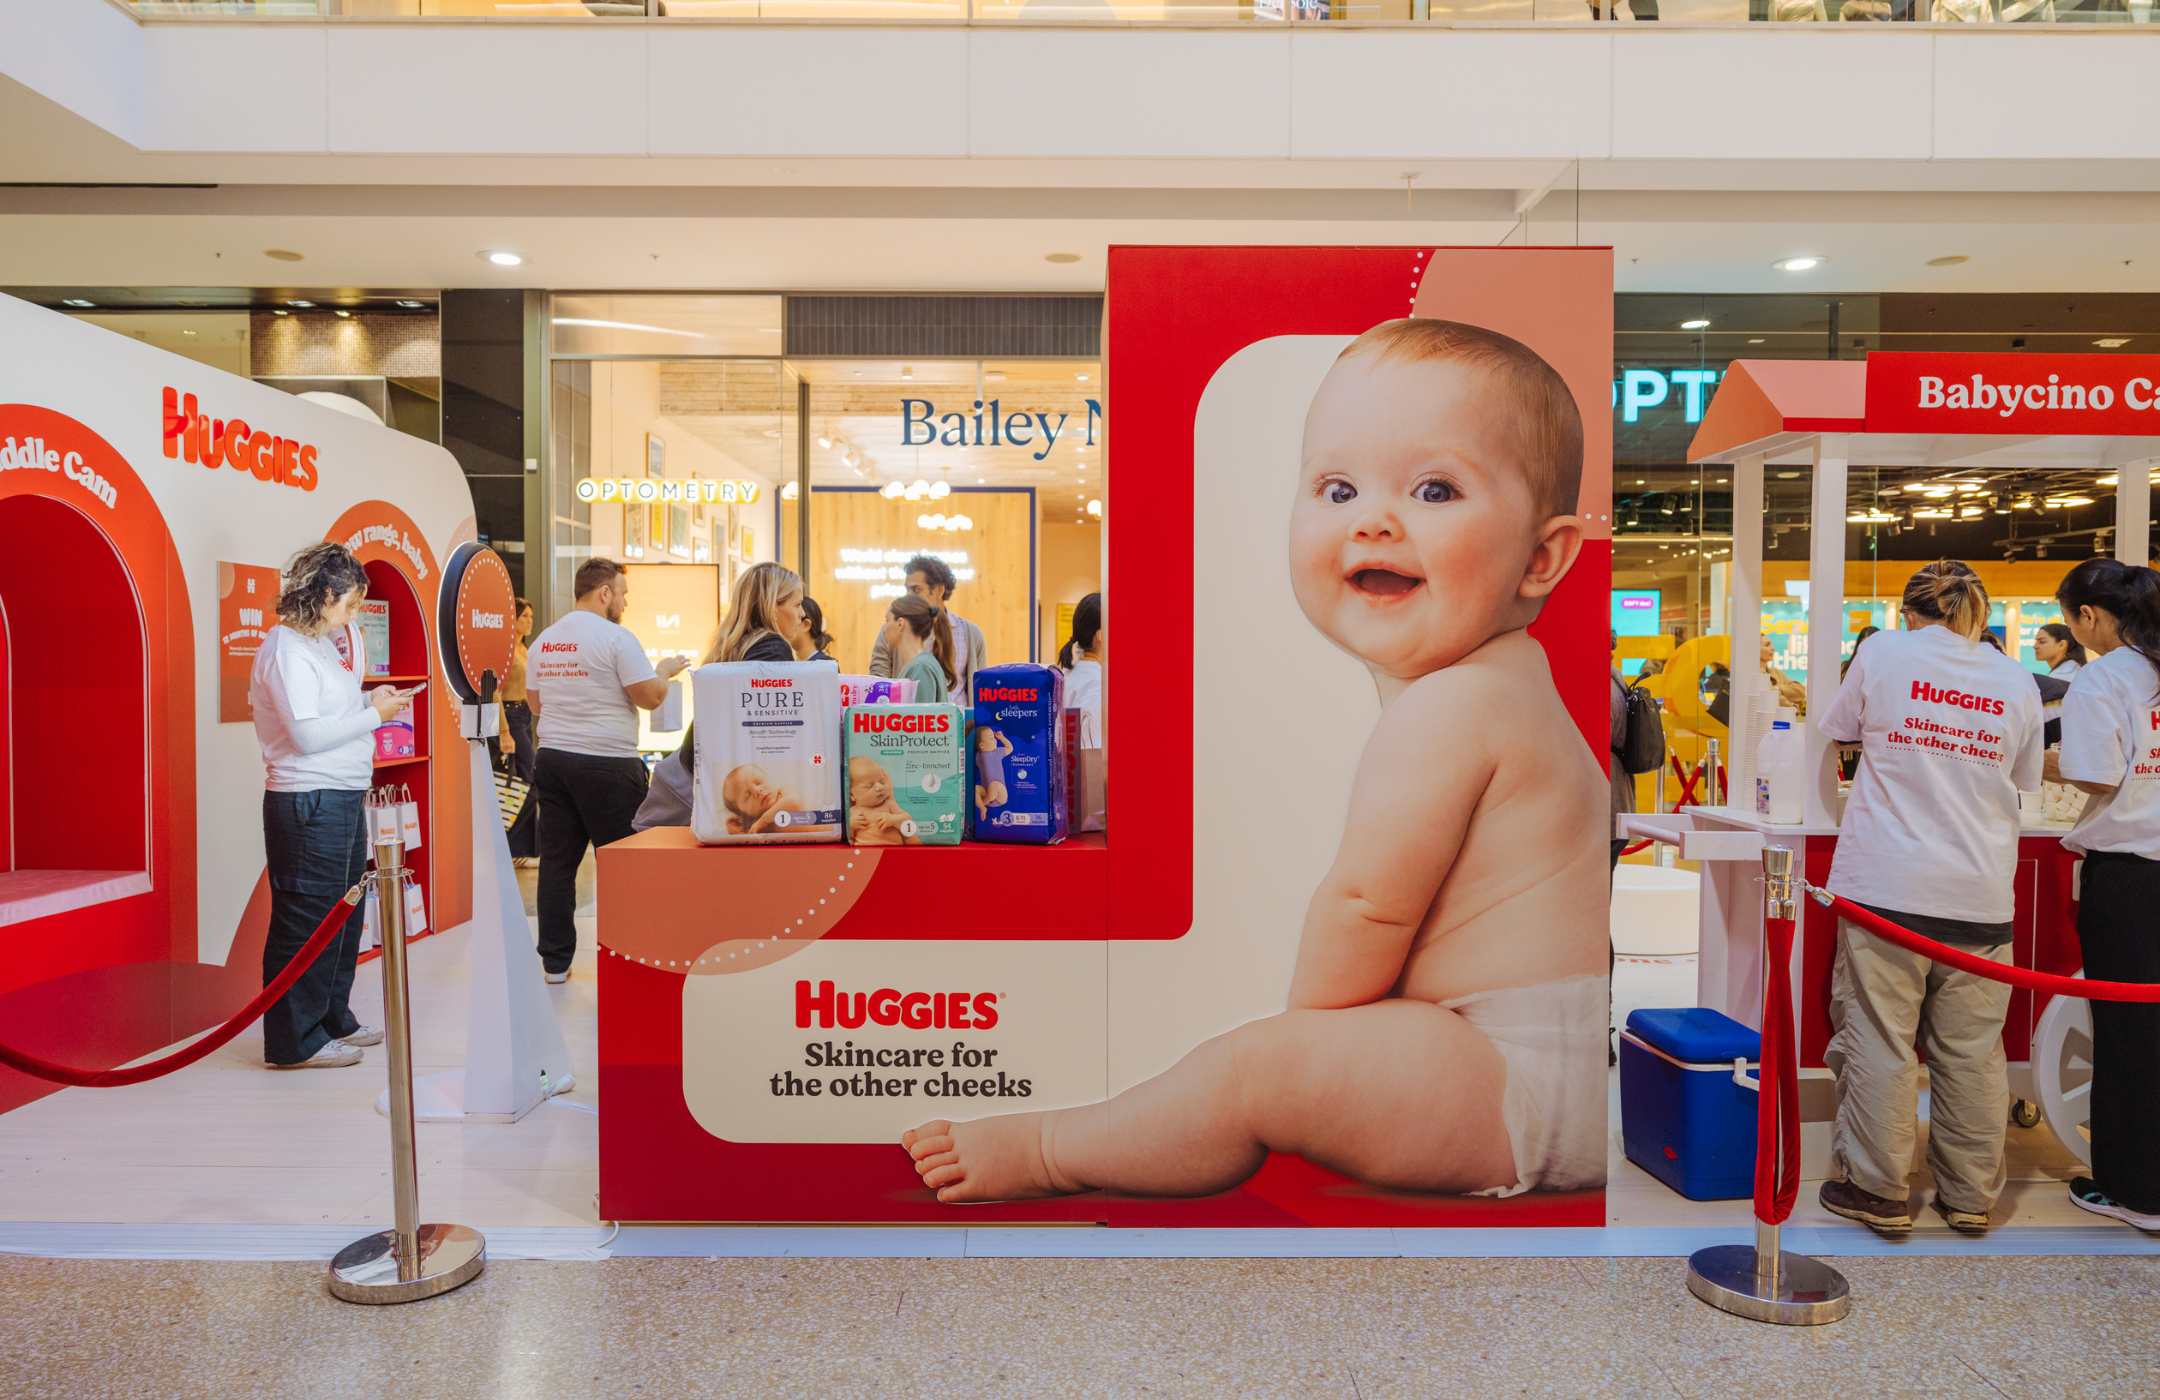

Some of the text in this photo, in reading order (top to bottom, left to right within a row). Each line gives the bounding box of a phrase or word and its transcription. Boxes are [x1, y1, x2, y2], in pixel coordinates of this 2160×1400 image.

[1613, 369, 1727, 423] PT
[1918, 374, 2114, 417] Babycino
[163, 386, 319, 492] HUGGIES
[900, 398, 1068, 460] Bailey
[0, 436, 117, 509] ddle Cam
[578, 482, 754, 499] OPTOMETRY
[343, 530, 363, 556] ew
[401, 531, 428, 580] baby
[239, 607, 263, 627] WIN
[471, 609, 503, 629] HUGGIES
[250, 629, 258, 637] OF
[541, 642, 578, 653] HUGGIES
[540, 660, 579, 669] Skincare for
[751, 678, 793, 688] HUGGIES
[741, 691, 804, 708] PURE
[979, 687, 1038, 702] HUGGIES
[1911, 680, 2005, 715] HUGGIES
[854, 713, 949, 733] HUGGIES
[1001, 708, 1038, 719] sleepers
[870, 734, 950, 747] SkinProtect
[1904, 717, 2001, 744] Skincare for
[1888, 731, 1912, 744] the
[1915, 736, 1958, 752] other
[2134, 763, 2153, 774] the
[780, 814, 785, 824] 1
[906, 823, 911, 832] 1
[1004, 813, 1010, 824] 3
[795, 980, 999, 1030] HUGGIES
[804, 1040, 998, 1067] Skincare for
[770, 1070, 1032, 1097] the other cheeks
